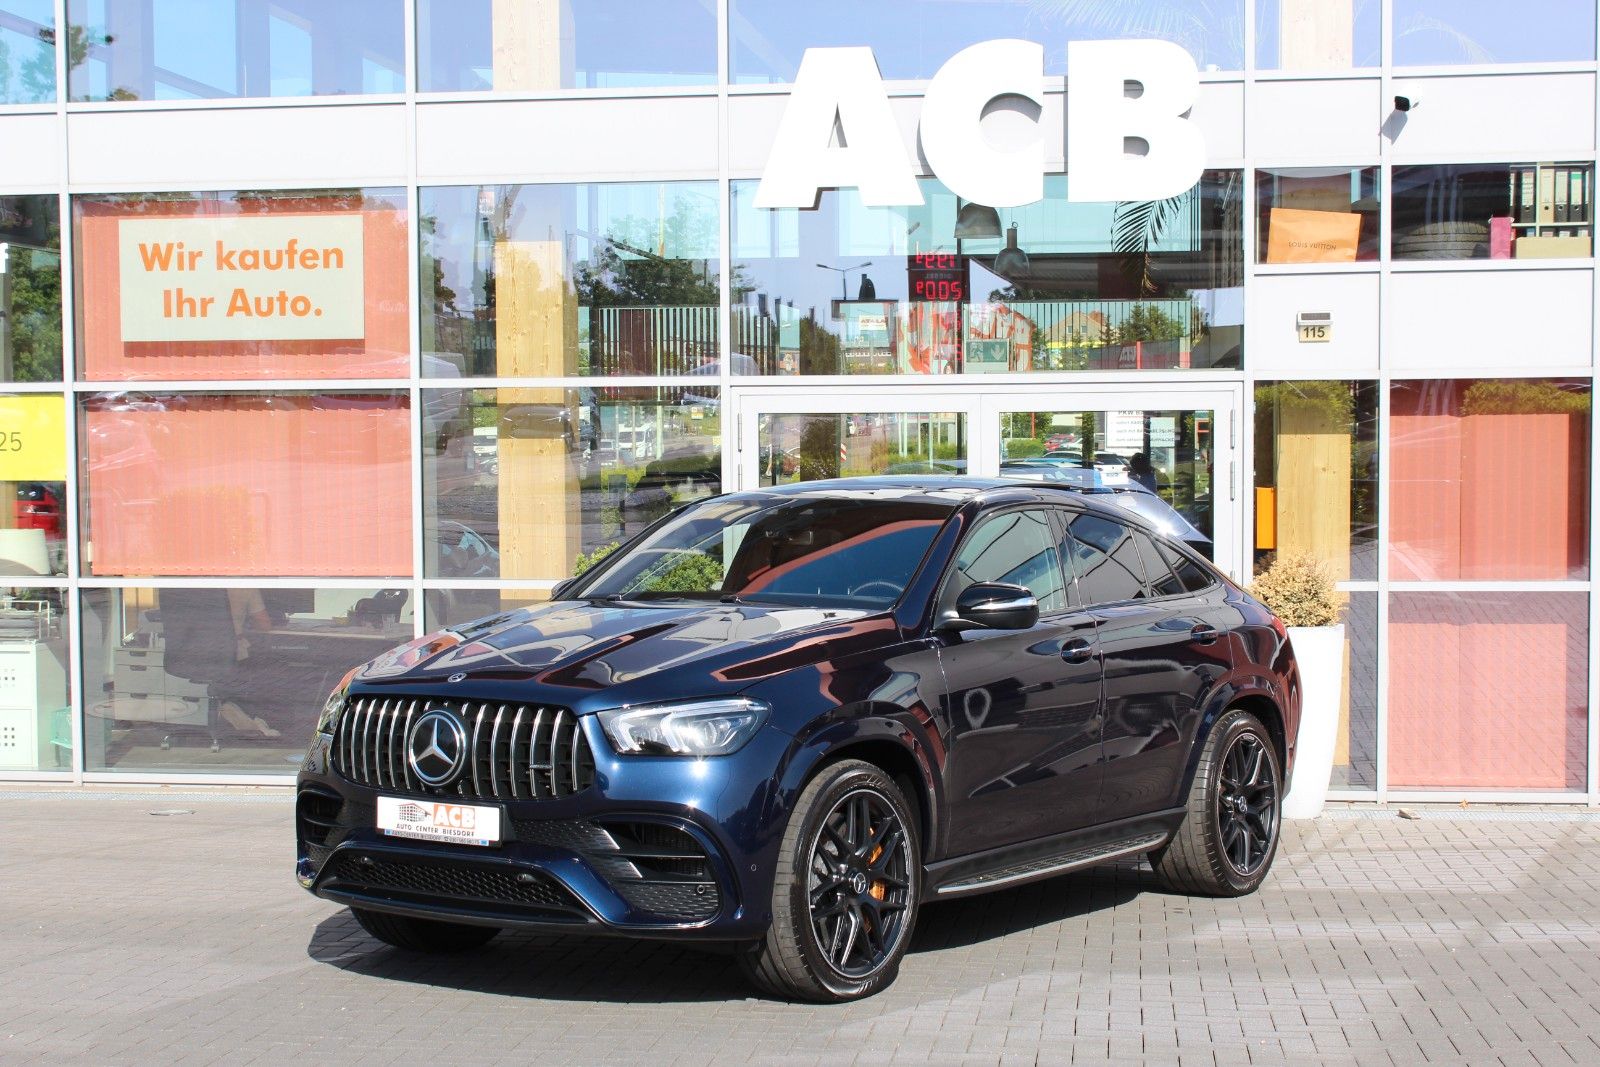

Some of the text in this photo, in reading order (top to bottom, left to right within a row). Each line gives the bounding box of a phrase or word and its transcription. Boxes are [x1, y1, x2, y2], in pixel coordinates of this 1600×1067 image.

[752, 38, 1206, 207] ACB
[138, 238, 344, 271] Wir kaufen
[1288, 240, 1337, 251] LOUIS VUITTON
[163, 287, 323, 318] Ihr Auto.
[1303, 326, 1325, 338] 115
[433, 804, 475, 829] ACB
[396, 823, 475, 837] AUTO CENTER BIESDORF
